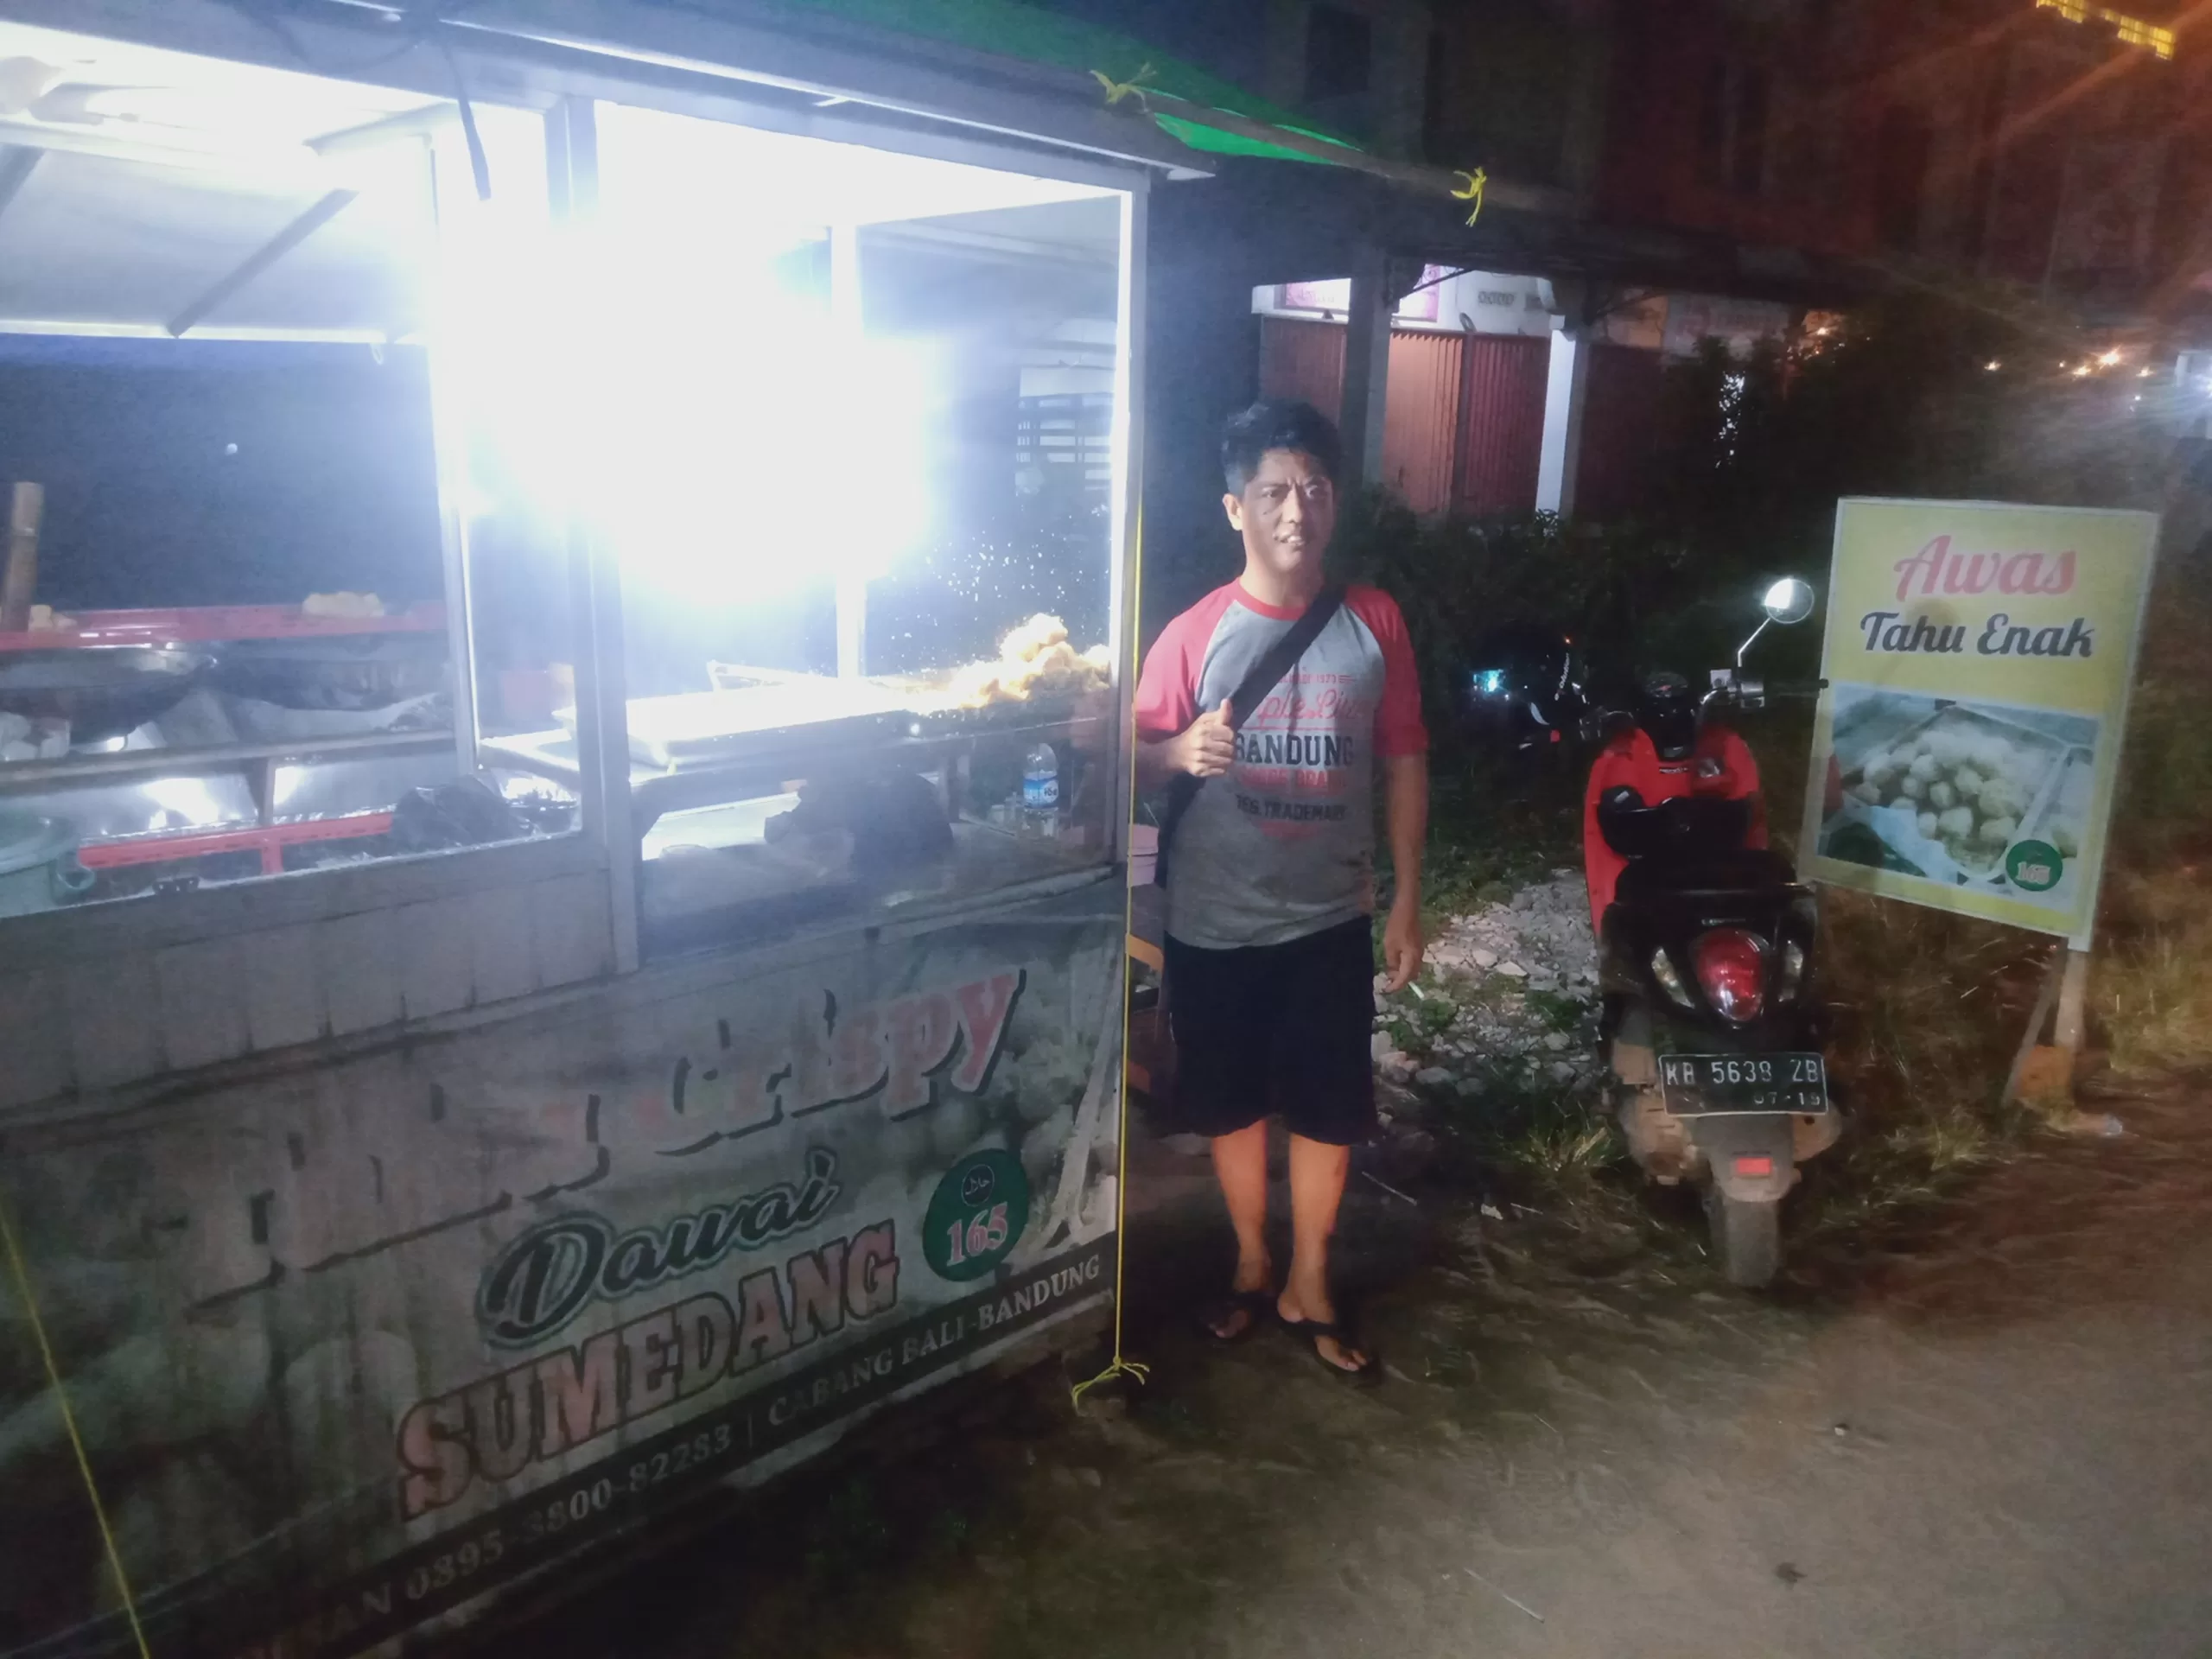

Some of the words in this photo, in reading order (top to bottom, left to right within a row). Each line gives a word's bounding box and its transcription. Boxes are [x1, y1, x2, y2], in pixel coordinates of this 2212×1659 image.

[1893, 535, 2076, 602] Awas
[1860, 611, 1967, 653] Tahu
[1976, 613, 2095, 658] Enak
[1236, 734, 1354, 766] BANDUNG
[1665, 1061, 1696, 1086] KB
[1789, 1058, 1819, 1084] ZB
[946, 1202, 1009, 1268] 165
[397, 1218, 899, 1520] SUMEDANG
[767, 1346, 893, 1427] CABANG
